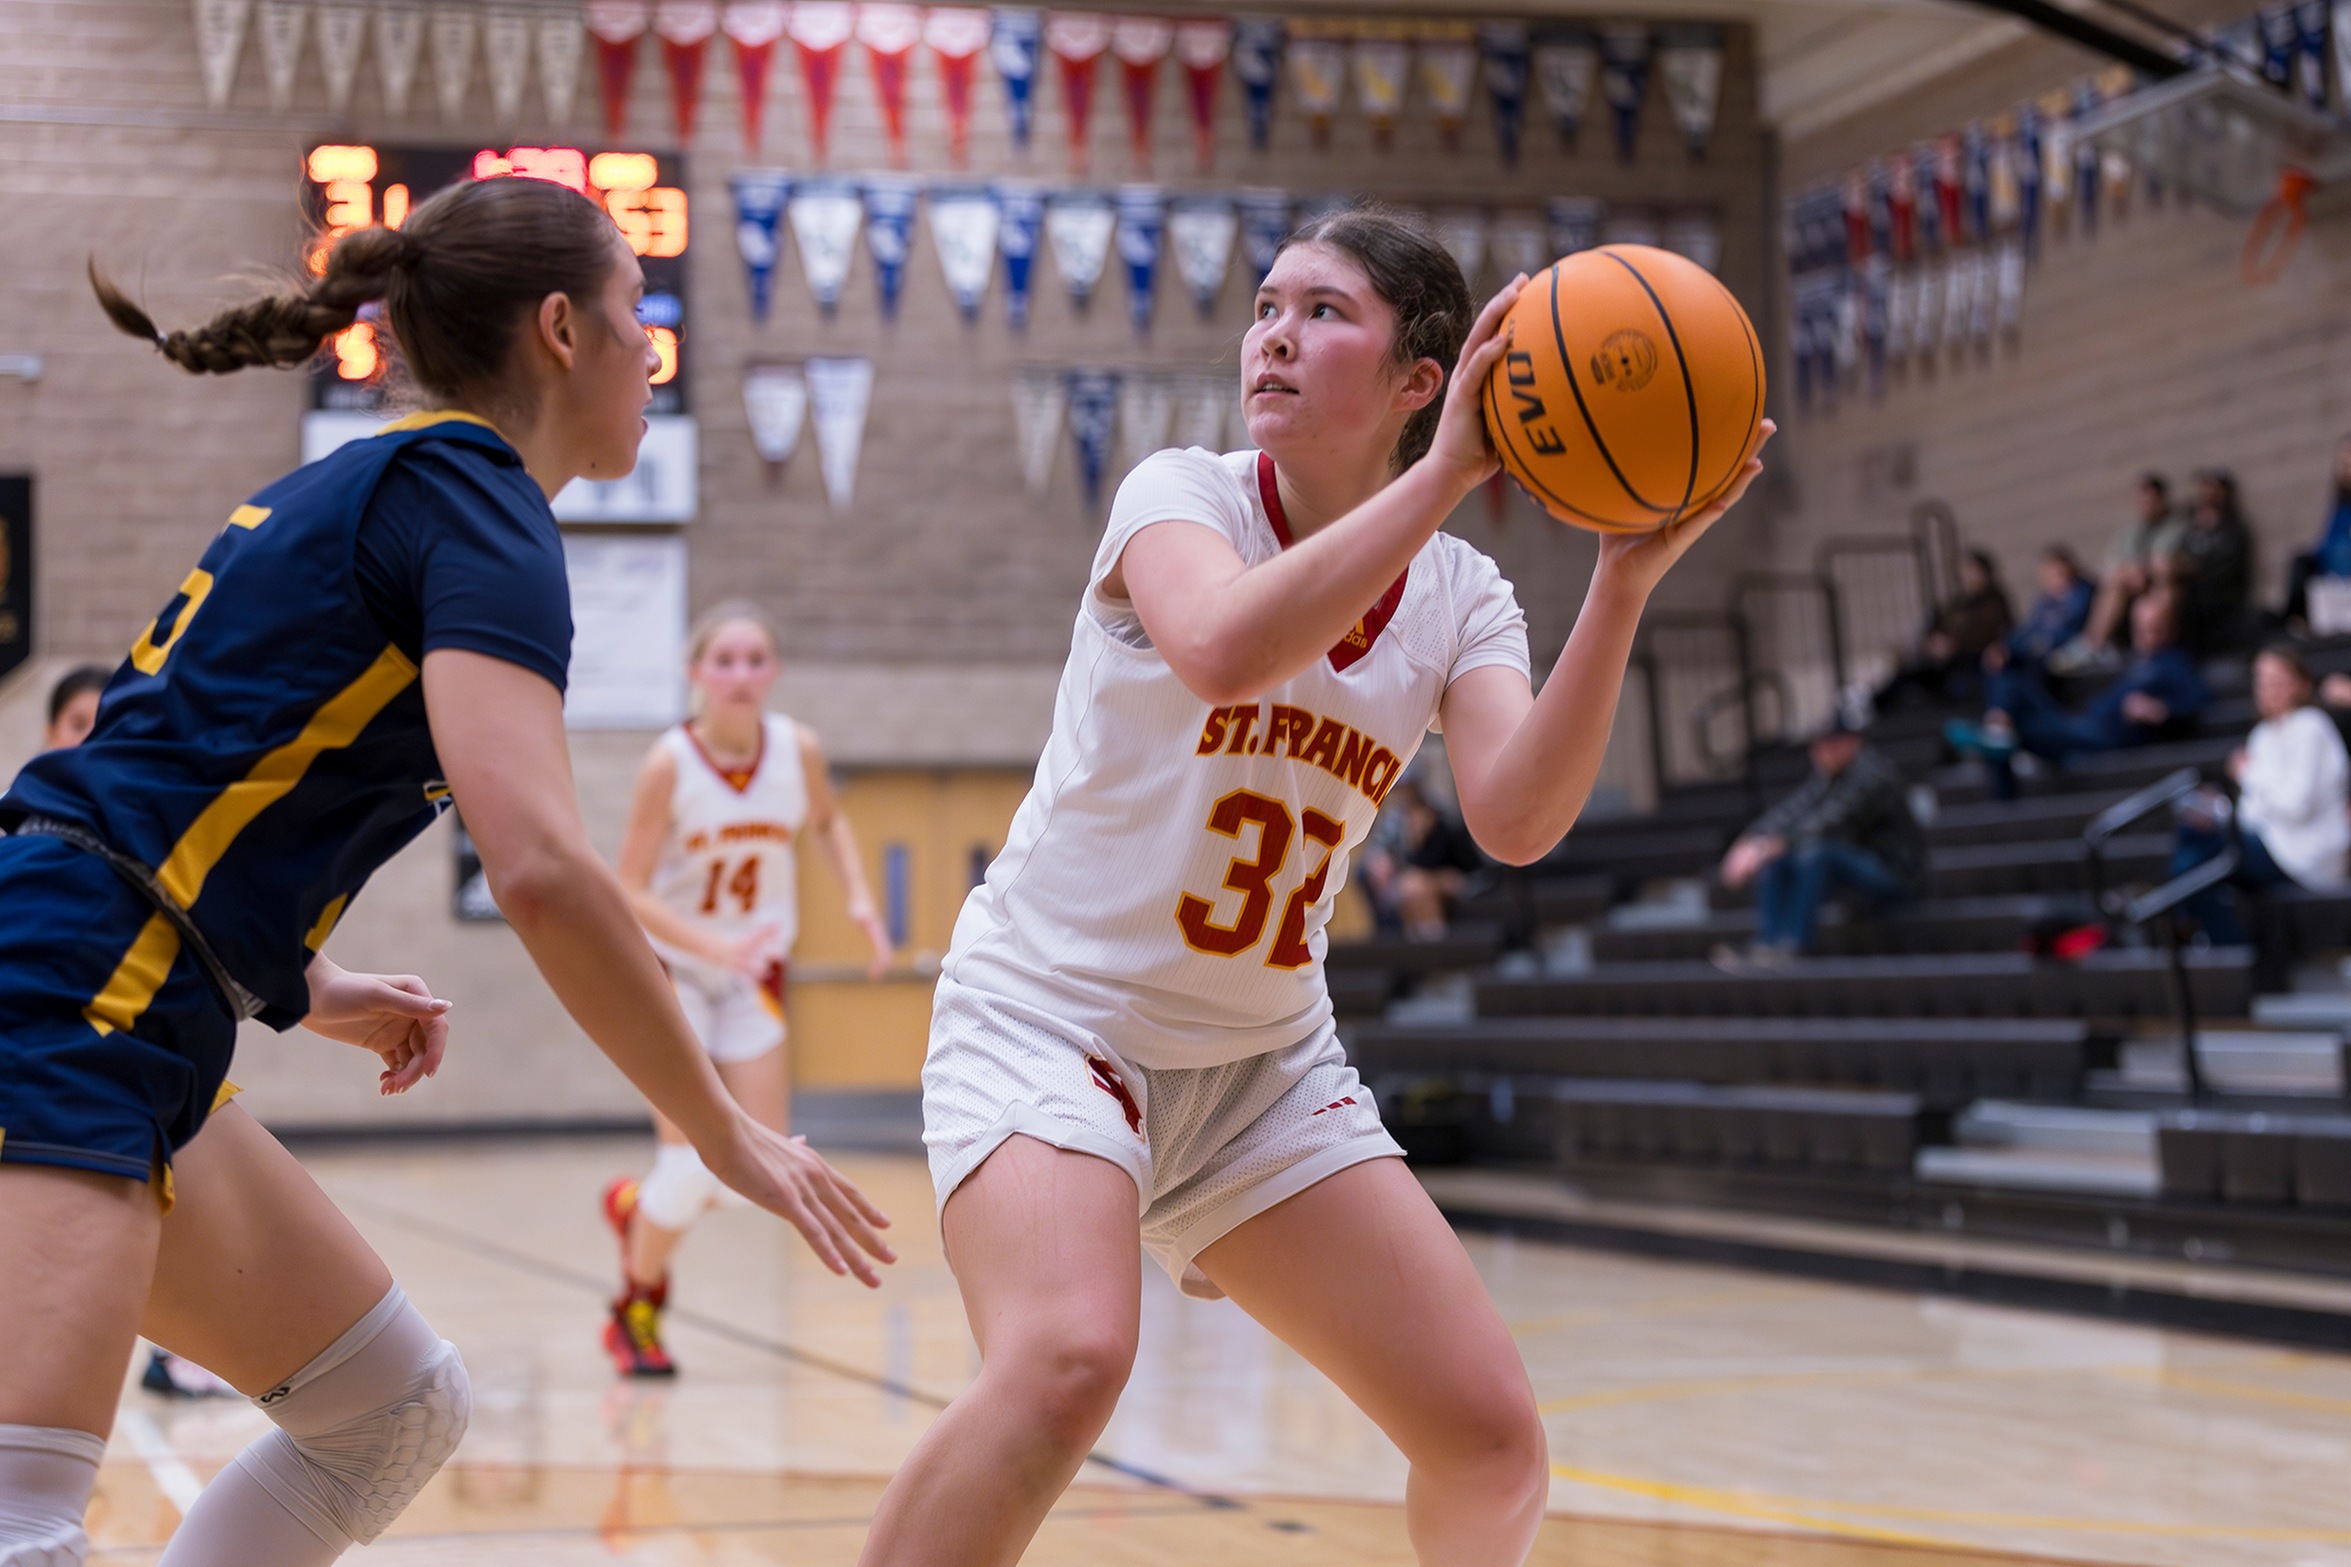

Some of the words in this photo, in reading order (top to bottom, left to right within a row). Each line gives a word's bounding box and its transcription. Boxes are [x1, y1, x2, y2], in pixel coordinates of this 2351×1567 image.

[1507, 352, 1567, 455] EVO
[1260, 703, 1401, 812] FRANCI
[699, 857, 760, 914] 14
[1175, 787, 1345, 970] 32
